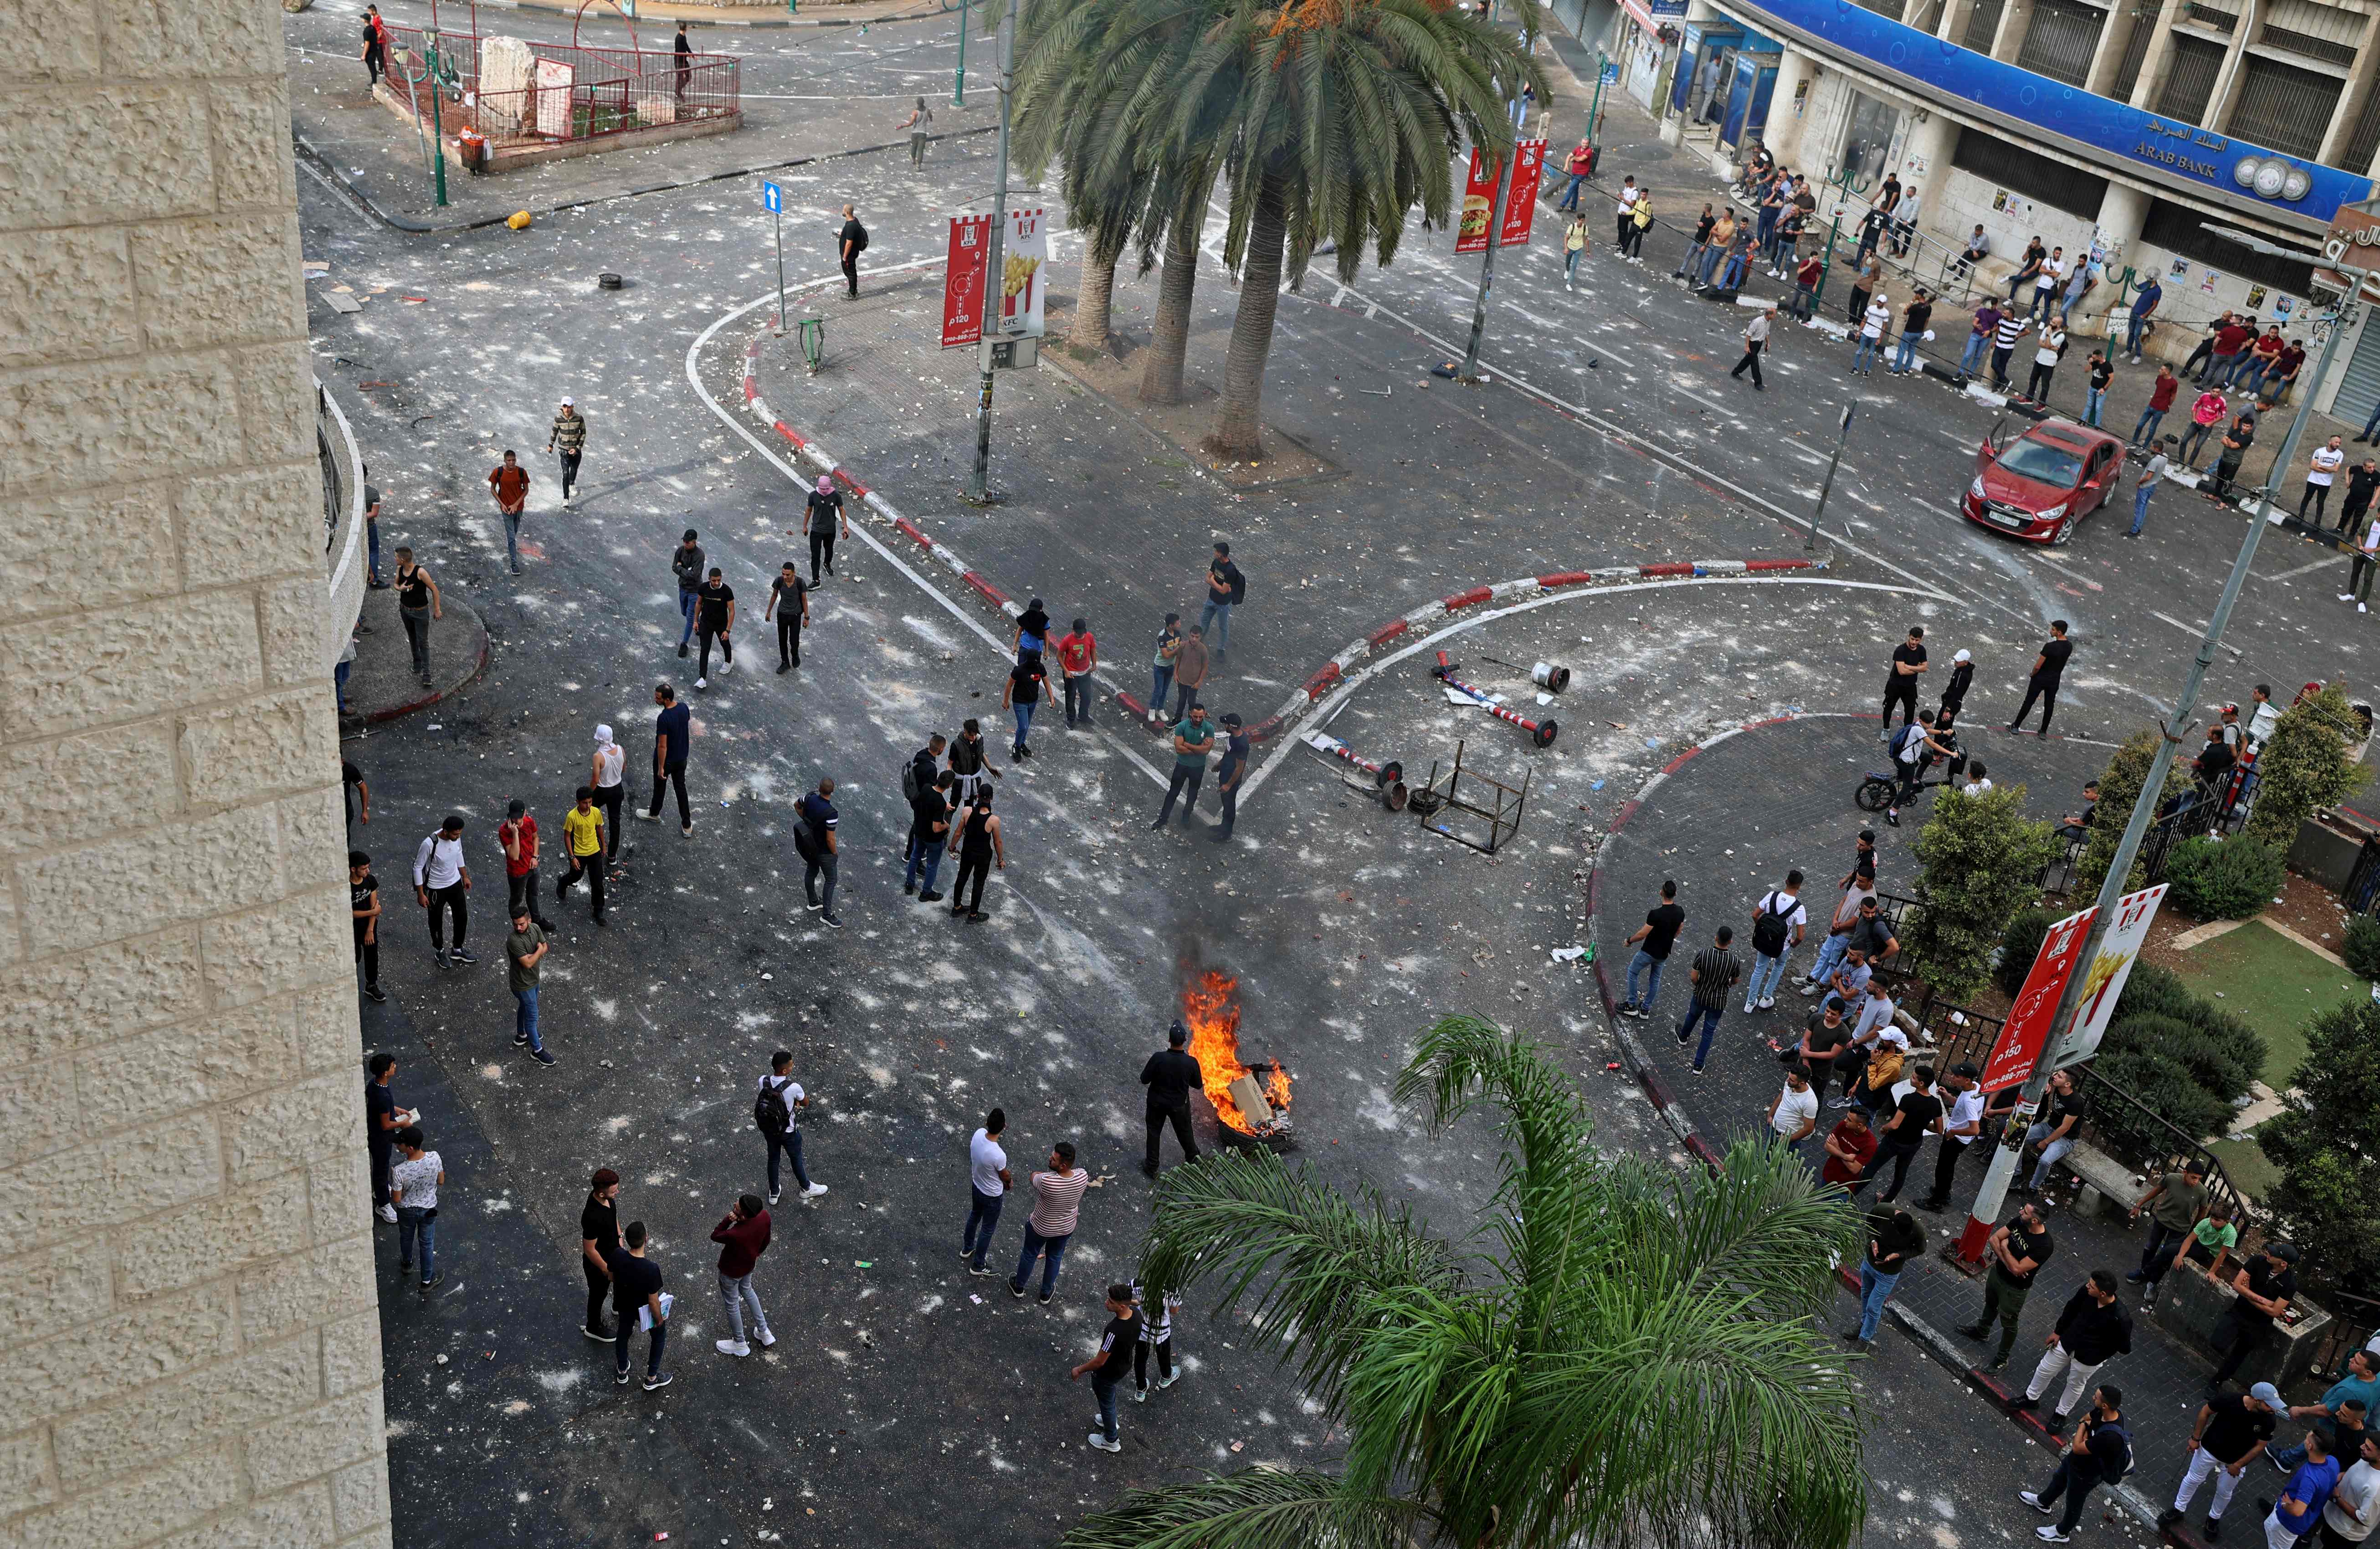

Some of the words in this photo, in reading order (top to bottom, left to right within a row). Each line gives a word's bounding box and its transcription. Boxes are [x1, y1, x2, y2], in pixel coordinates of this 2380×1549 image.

[2145, 119, 2194, 141] العربي
[2194, 133, 2228, 153] البنك
[2133, 141, 2175, 164] ARAB
[2177, 155, 2217, 178] BANK
[1072, 644, 1084, 660] 7
[2118, 923, 2134, 933] KFC
[2051, 947, 2066, 956] KFC
[1983, 1068, 2030, 1089] 1700-888-777
[1260, 1102, 1269, 1116] BOTTLE
